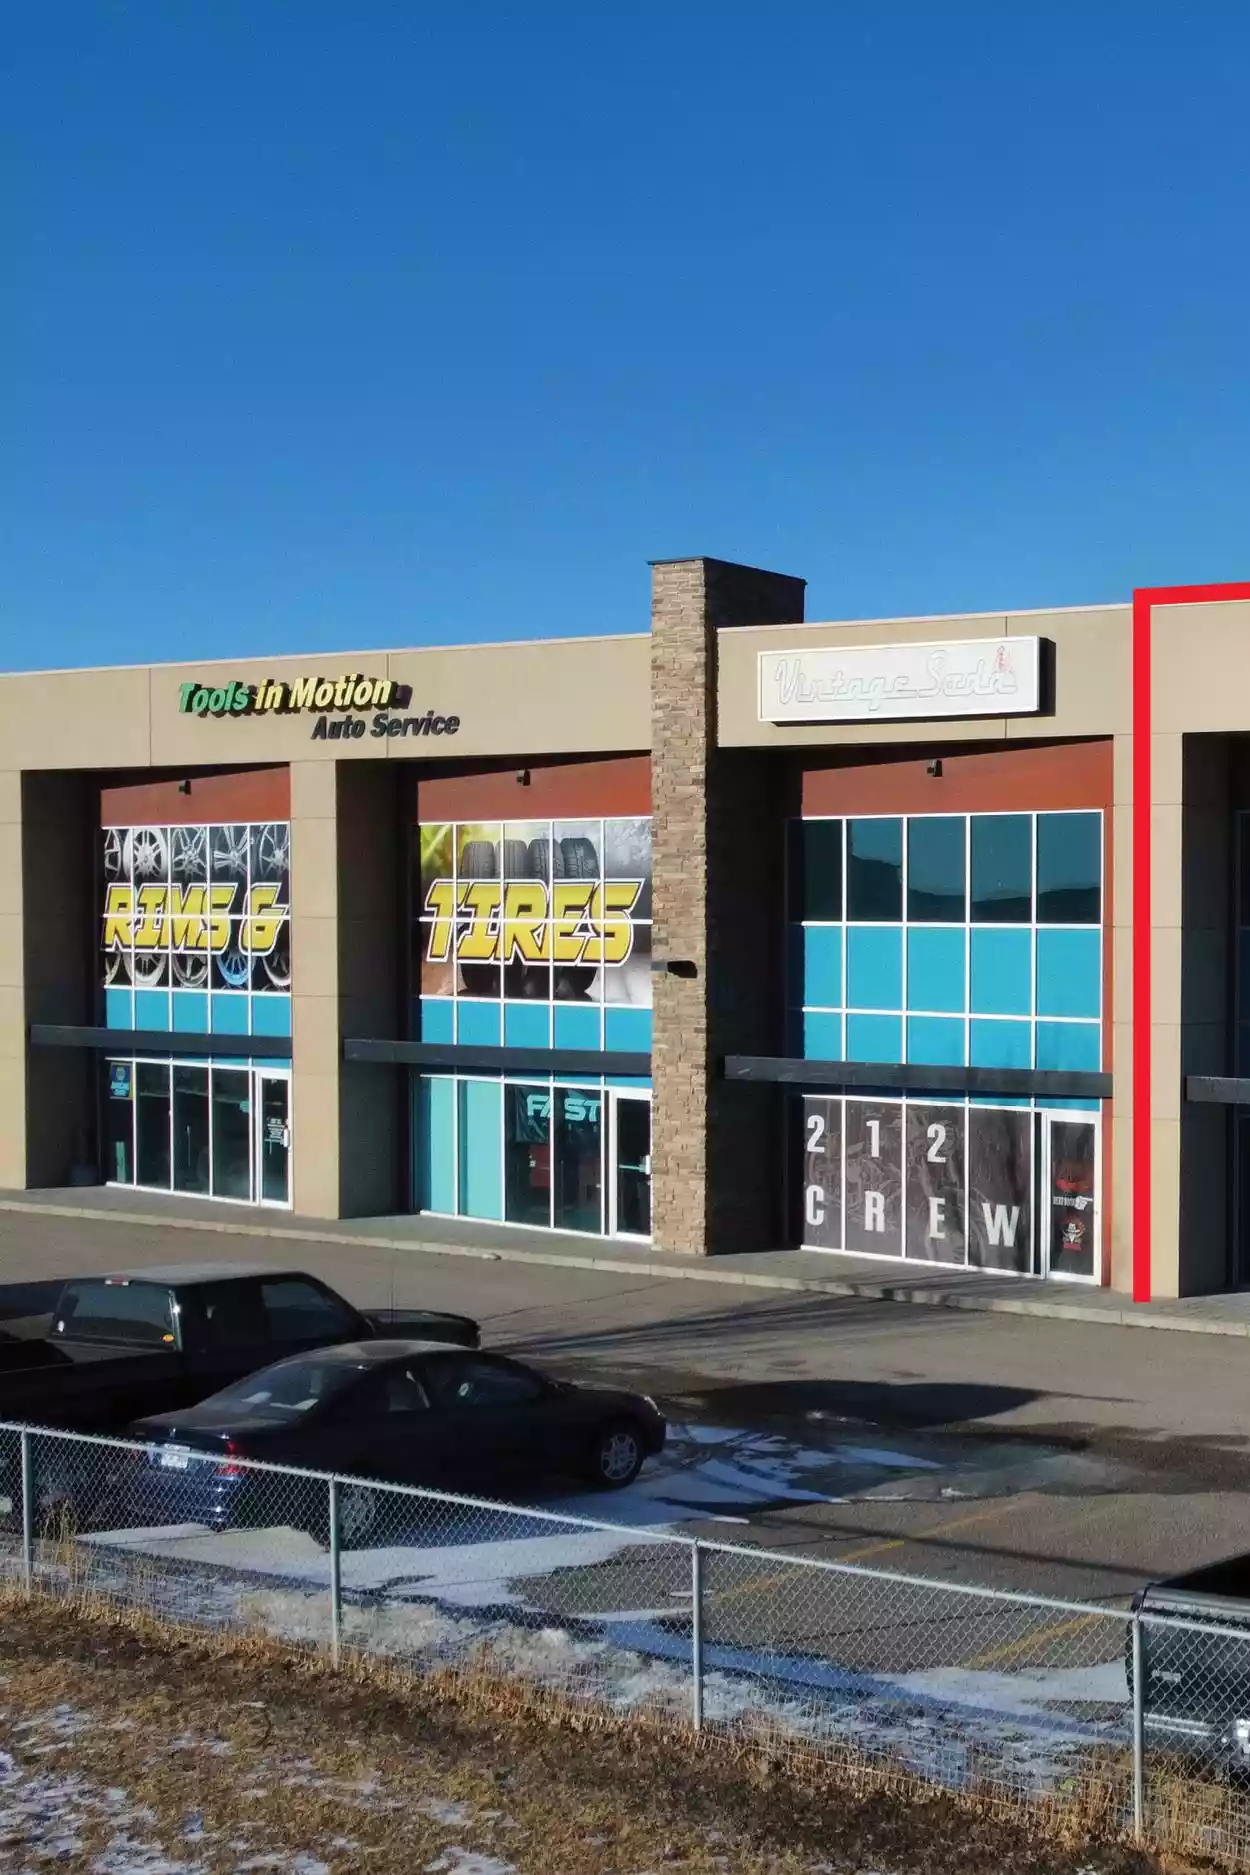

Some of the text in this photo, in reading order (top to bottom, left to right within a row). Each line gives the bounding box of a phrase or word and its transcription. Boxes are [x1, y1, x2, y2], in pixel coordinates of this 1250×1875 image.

[178, 674, 392, 713] Tools in Motion
[775, 650, 1018, 711] Vintage Soda
[310, 710, 460, 740] Auto Service
[104, 883, 238, 954] RIMS
[425, 879, 645, 966] TIRES
[806, 1185, 1020, 1247] CREW
